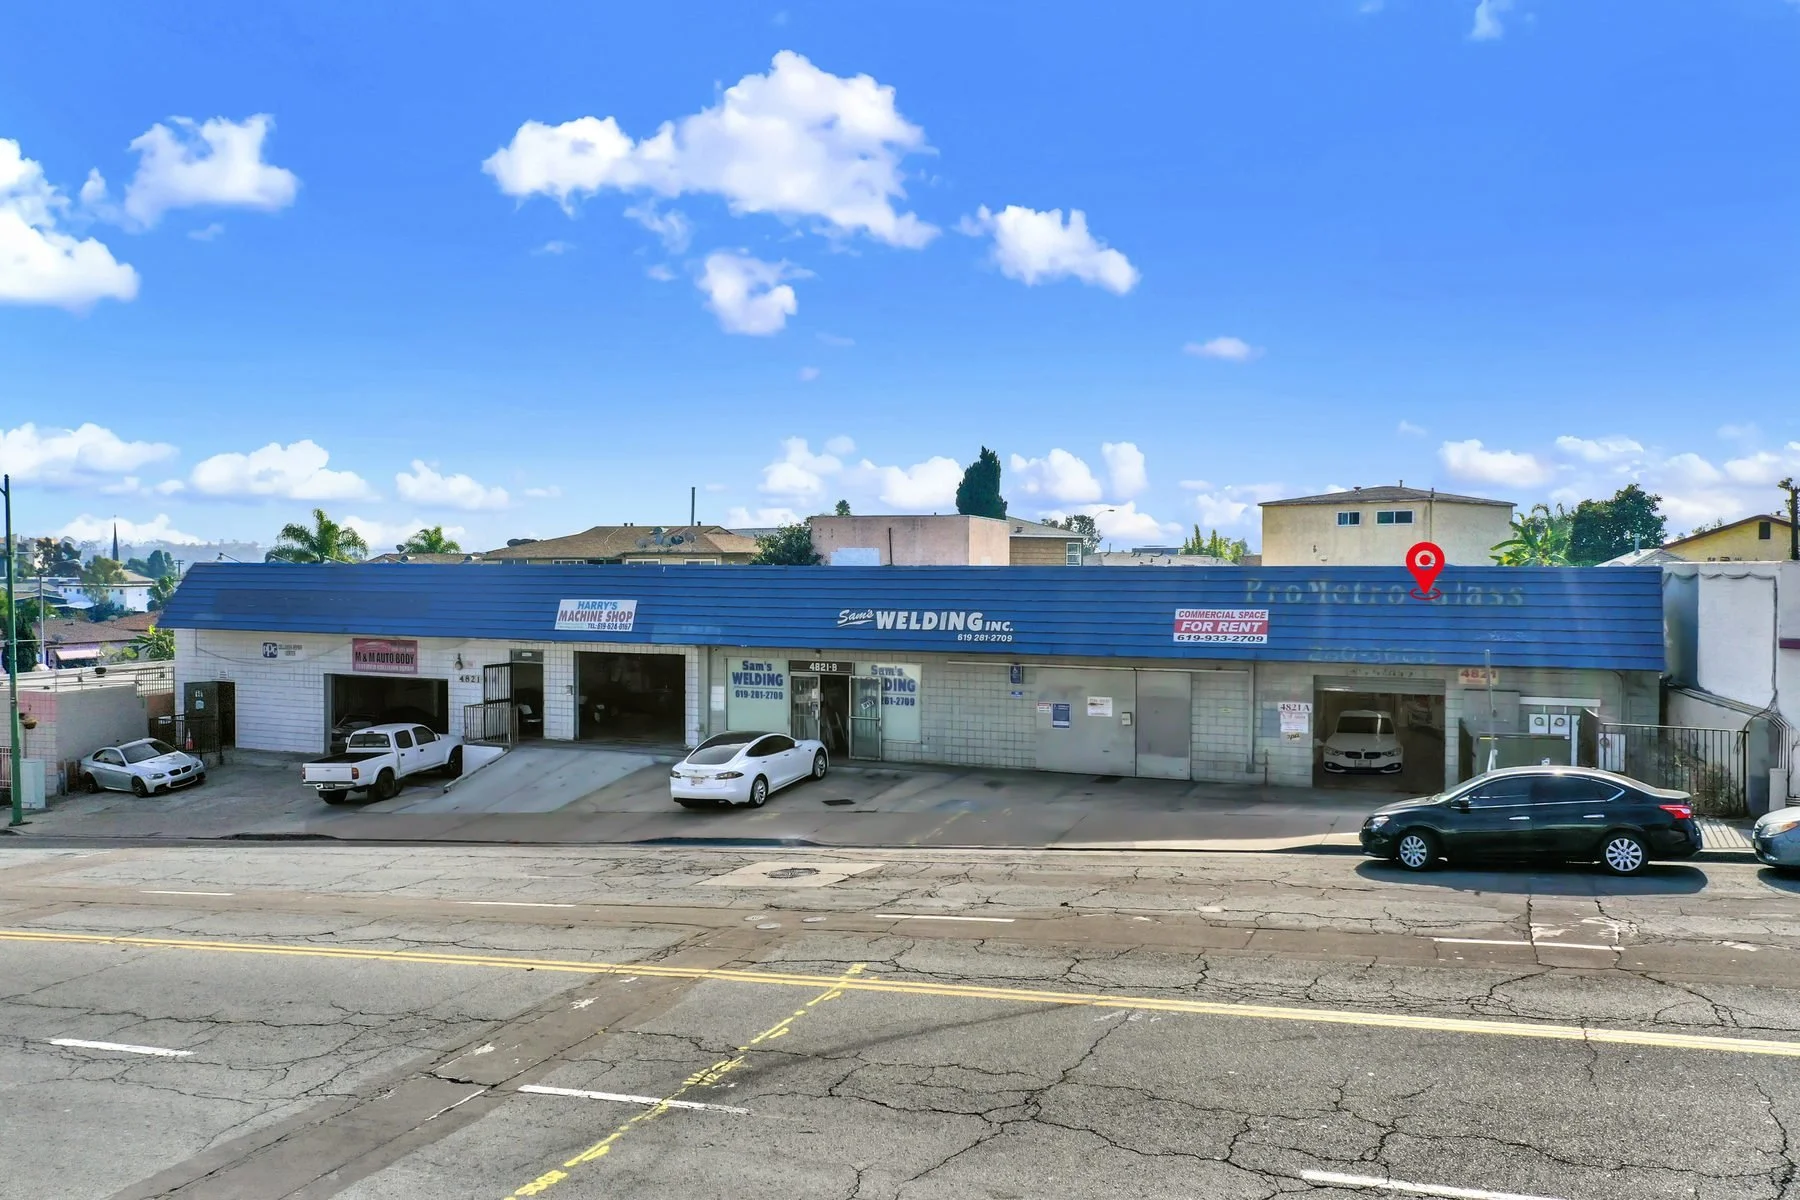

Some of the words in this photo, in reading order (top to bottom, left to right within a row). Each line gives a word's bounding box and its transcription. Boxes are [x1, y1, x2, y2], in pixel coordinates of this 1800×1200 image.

[577, 601, 618, 610] HARRY'S
[558, 610, 604, 622] MACHINE
[605, 611, 633, 622] SHOP
[1178, 610, 1236, 619] COMMERCIAL
[1238, 611, 1266, 619] SPACE
[837, 609, 875, 625] Sam's
[876, 611, 983, 632] WELDING
[985, 621, 1014, 632] INC.
[1180, 621, 1214, 632] FOR
[1217, 621, 1263, 632] RENT
[957, 634, 972, 642] 619
[1177, 634, 1264, 642] 619-933-2709
[362, 653, 368, 662] &
[376, 652, 394, 663] AUTO
[395, 653, 415, 664] BODY
[742, 660, 772, 671] Sam's
[871, 664, 904, 676] Sam's
[460, 675, 480, 683] 4821
[732, 671, 784, 687] WELDING
